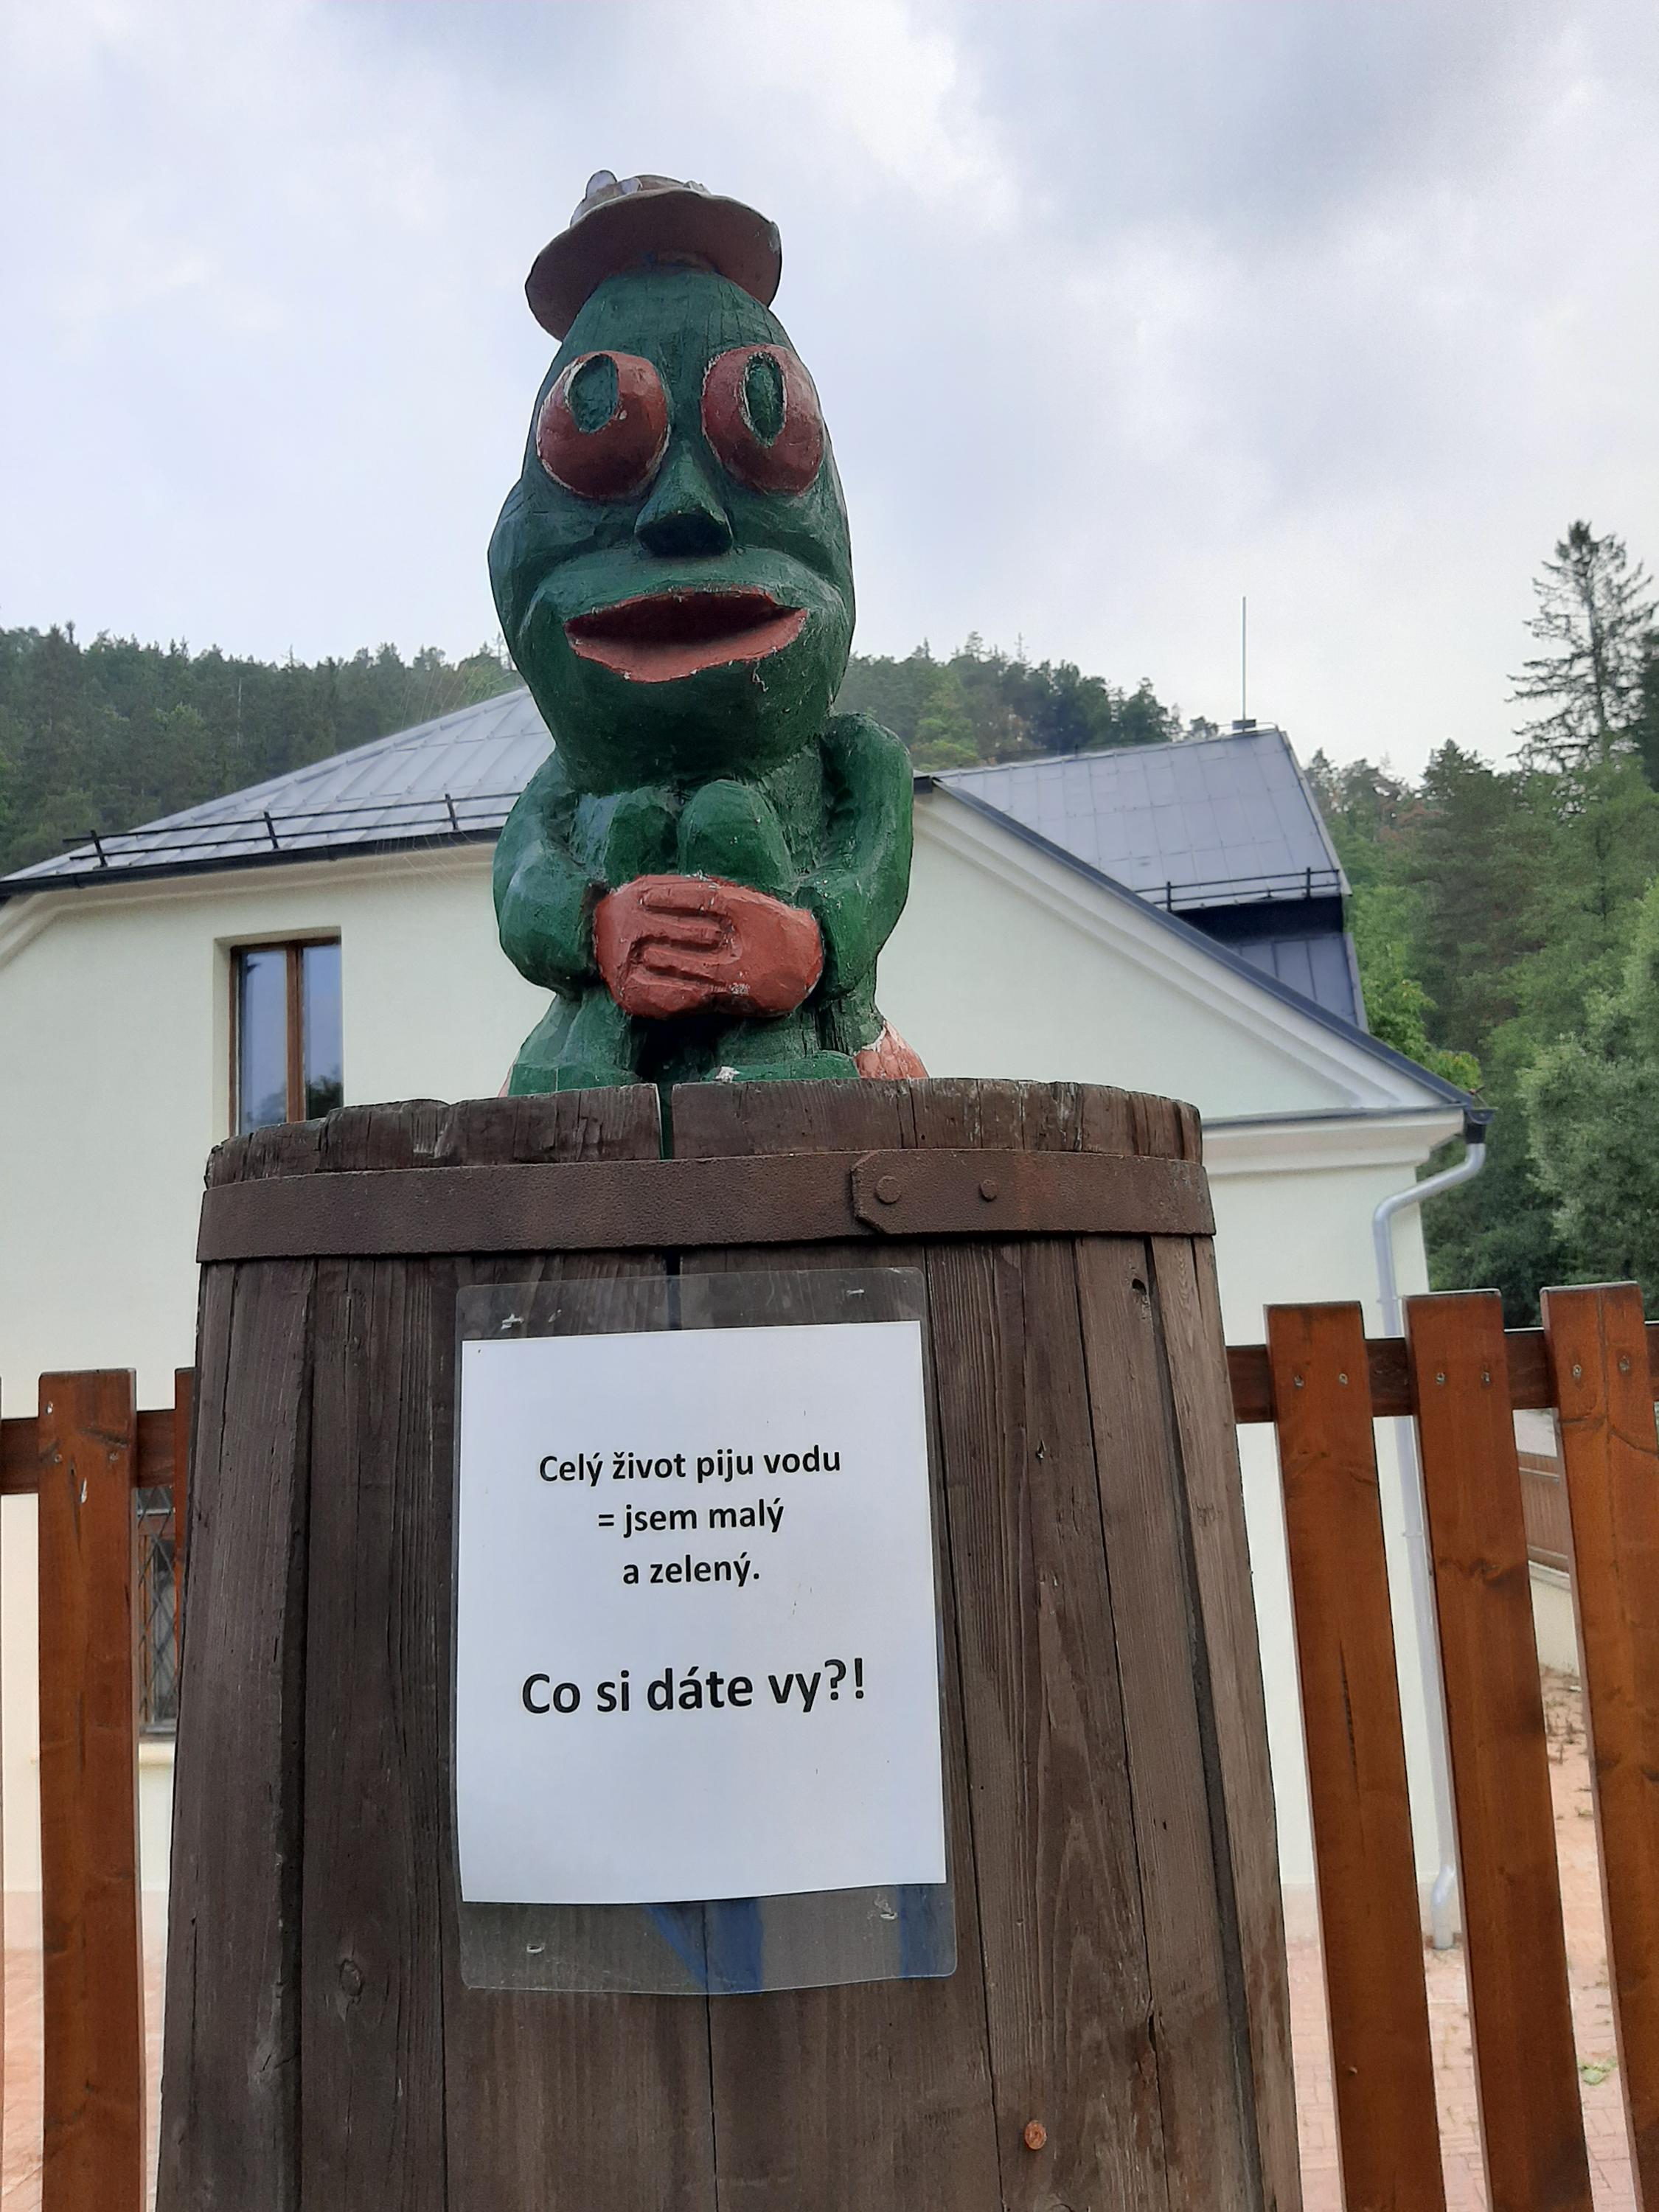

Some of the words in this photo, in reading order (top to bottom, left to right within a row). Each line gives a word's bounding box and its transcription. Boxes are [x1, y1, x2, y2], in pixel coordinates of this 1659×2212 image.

[539, 1452, 604, 1487] Celý
[612, 1451, 686, 1480] život
[697, 1448, 754, 1484] piju
[763, 1444, 841, 1475] vodu
[598, 1513, 615, 1527] =
[623, 1503, 698, 1539] jsem
[709, 1497, 785, 1533] malý
[622, 1564, 639, 1585] a
[650, 1551, 760, 1587] zelený.
[522, 1673, 581, 1714] Co
[597, 1669, 630, 1713] si
[647, 1666, 754, 1712] dáte
[768, 1658, 865, 1714] vy?!
